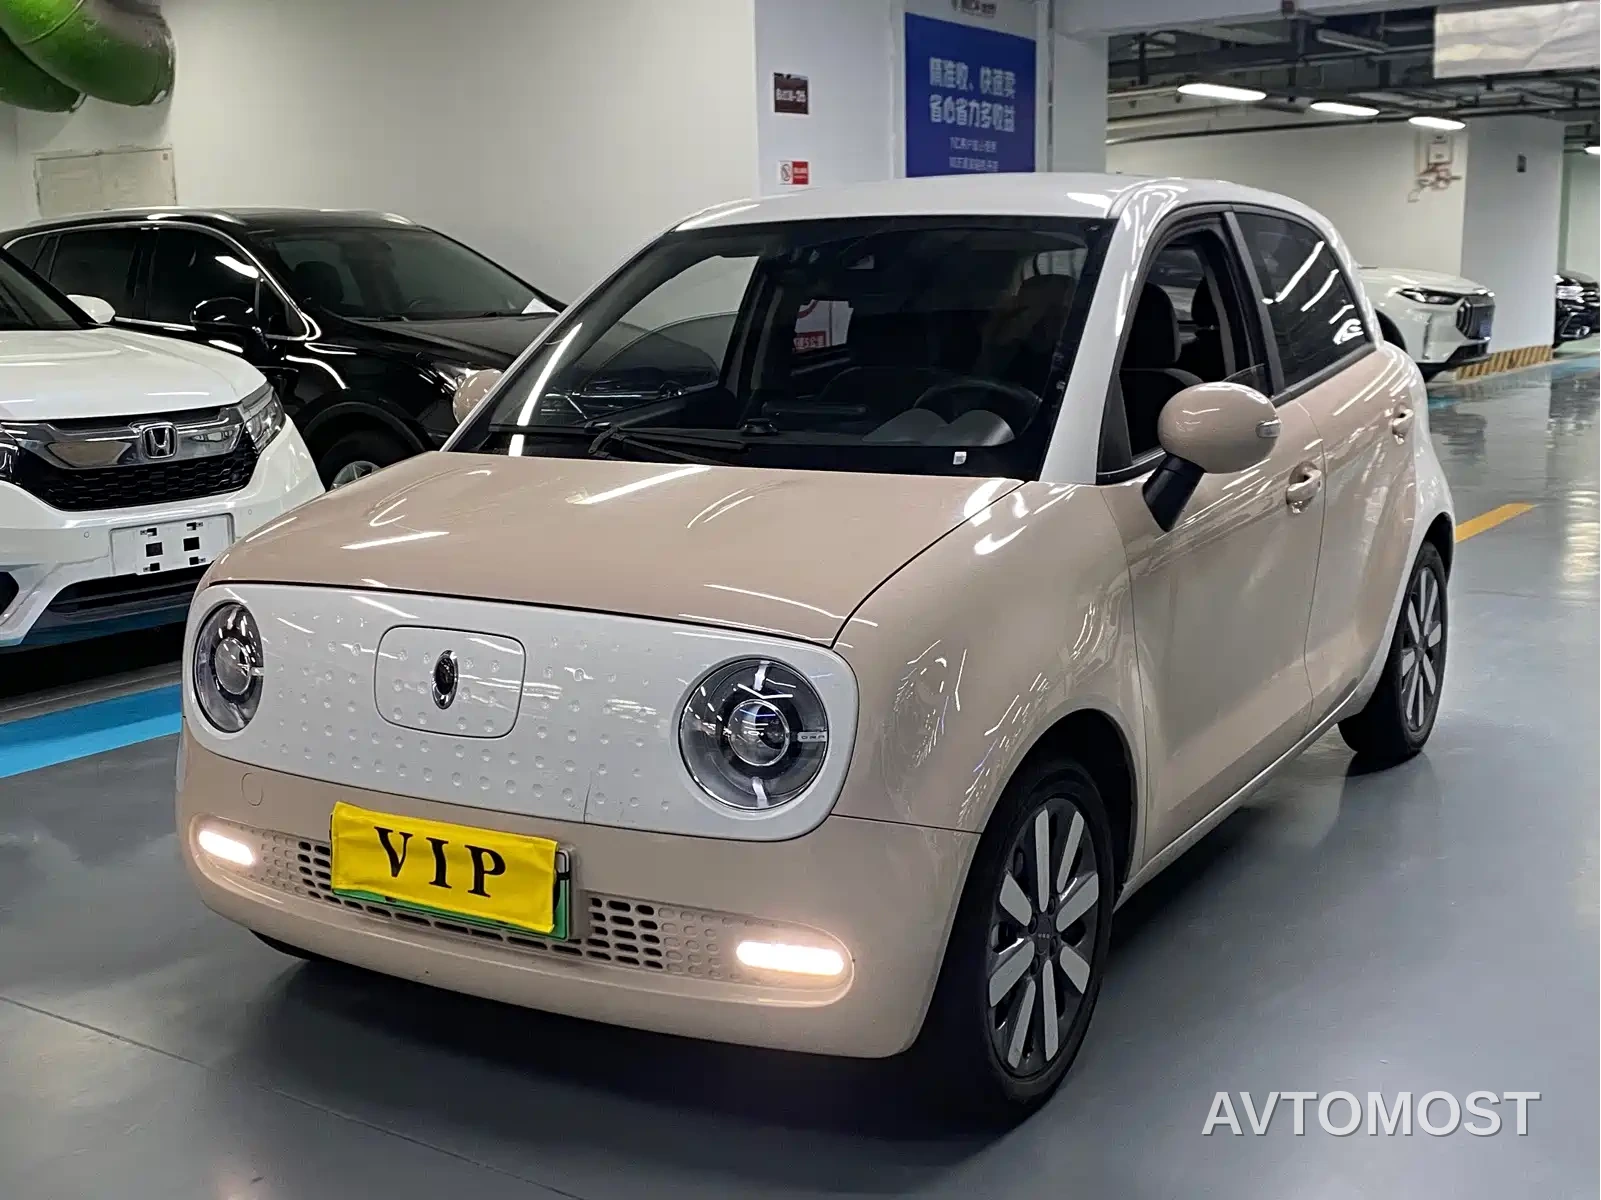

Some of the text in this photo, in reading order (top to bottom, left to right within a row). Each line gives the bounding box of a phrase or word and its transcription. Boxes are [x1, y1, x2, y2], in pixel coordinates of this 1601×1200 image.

[930, 94, 1015, 132] 省心省力多收益
[374, 826, 506, 898] VIP
